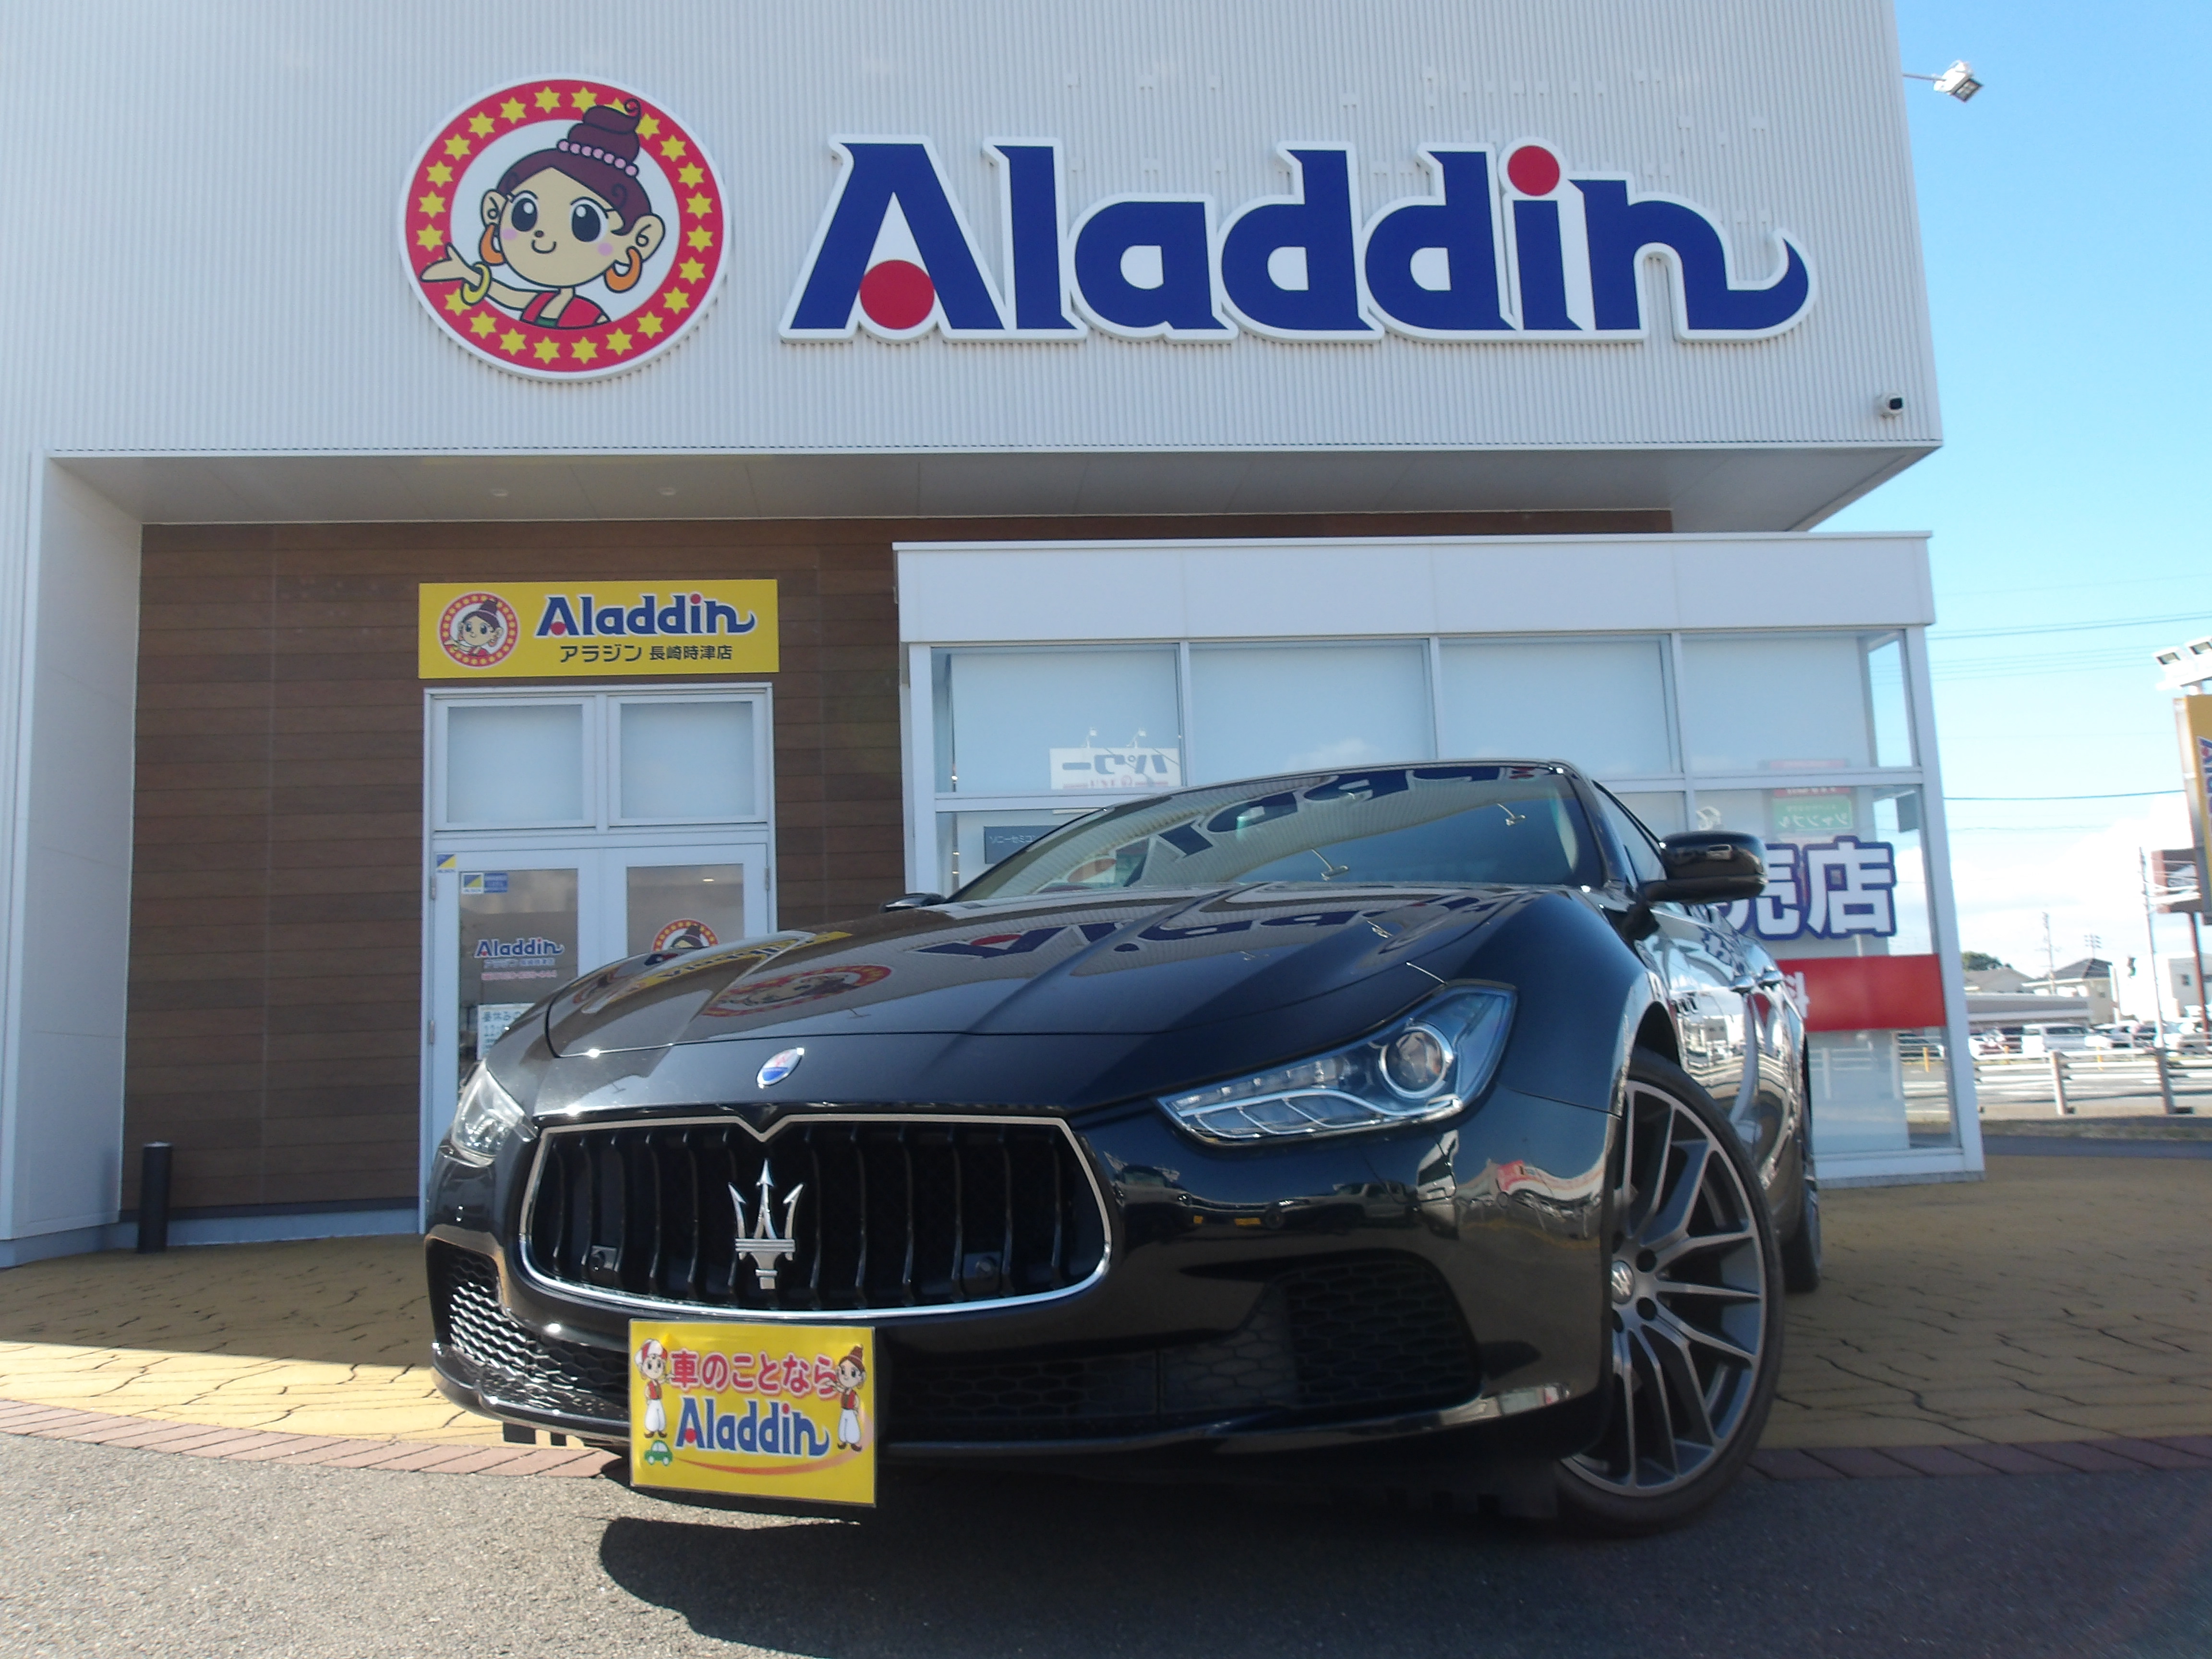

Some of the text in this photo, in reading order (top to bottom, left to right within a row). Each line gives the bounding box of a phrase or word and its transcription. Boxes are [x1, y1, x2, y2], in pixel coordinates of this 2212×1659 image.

[785, 139, 1813, 336] Aladdin
[537, 594, 757, 637] Aladdin
[560, 645, 733, 663] アラジン 長崎時津店
[475, 938, 565, 957] Aladdin
[670, 1351, 840, 1399] 車のことなら
[675, 1396, 830, 1457] Aladdin
